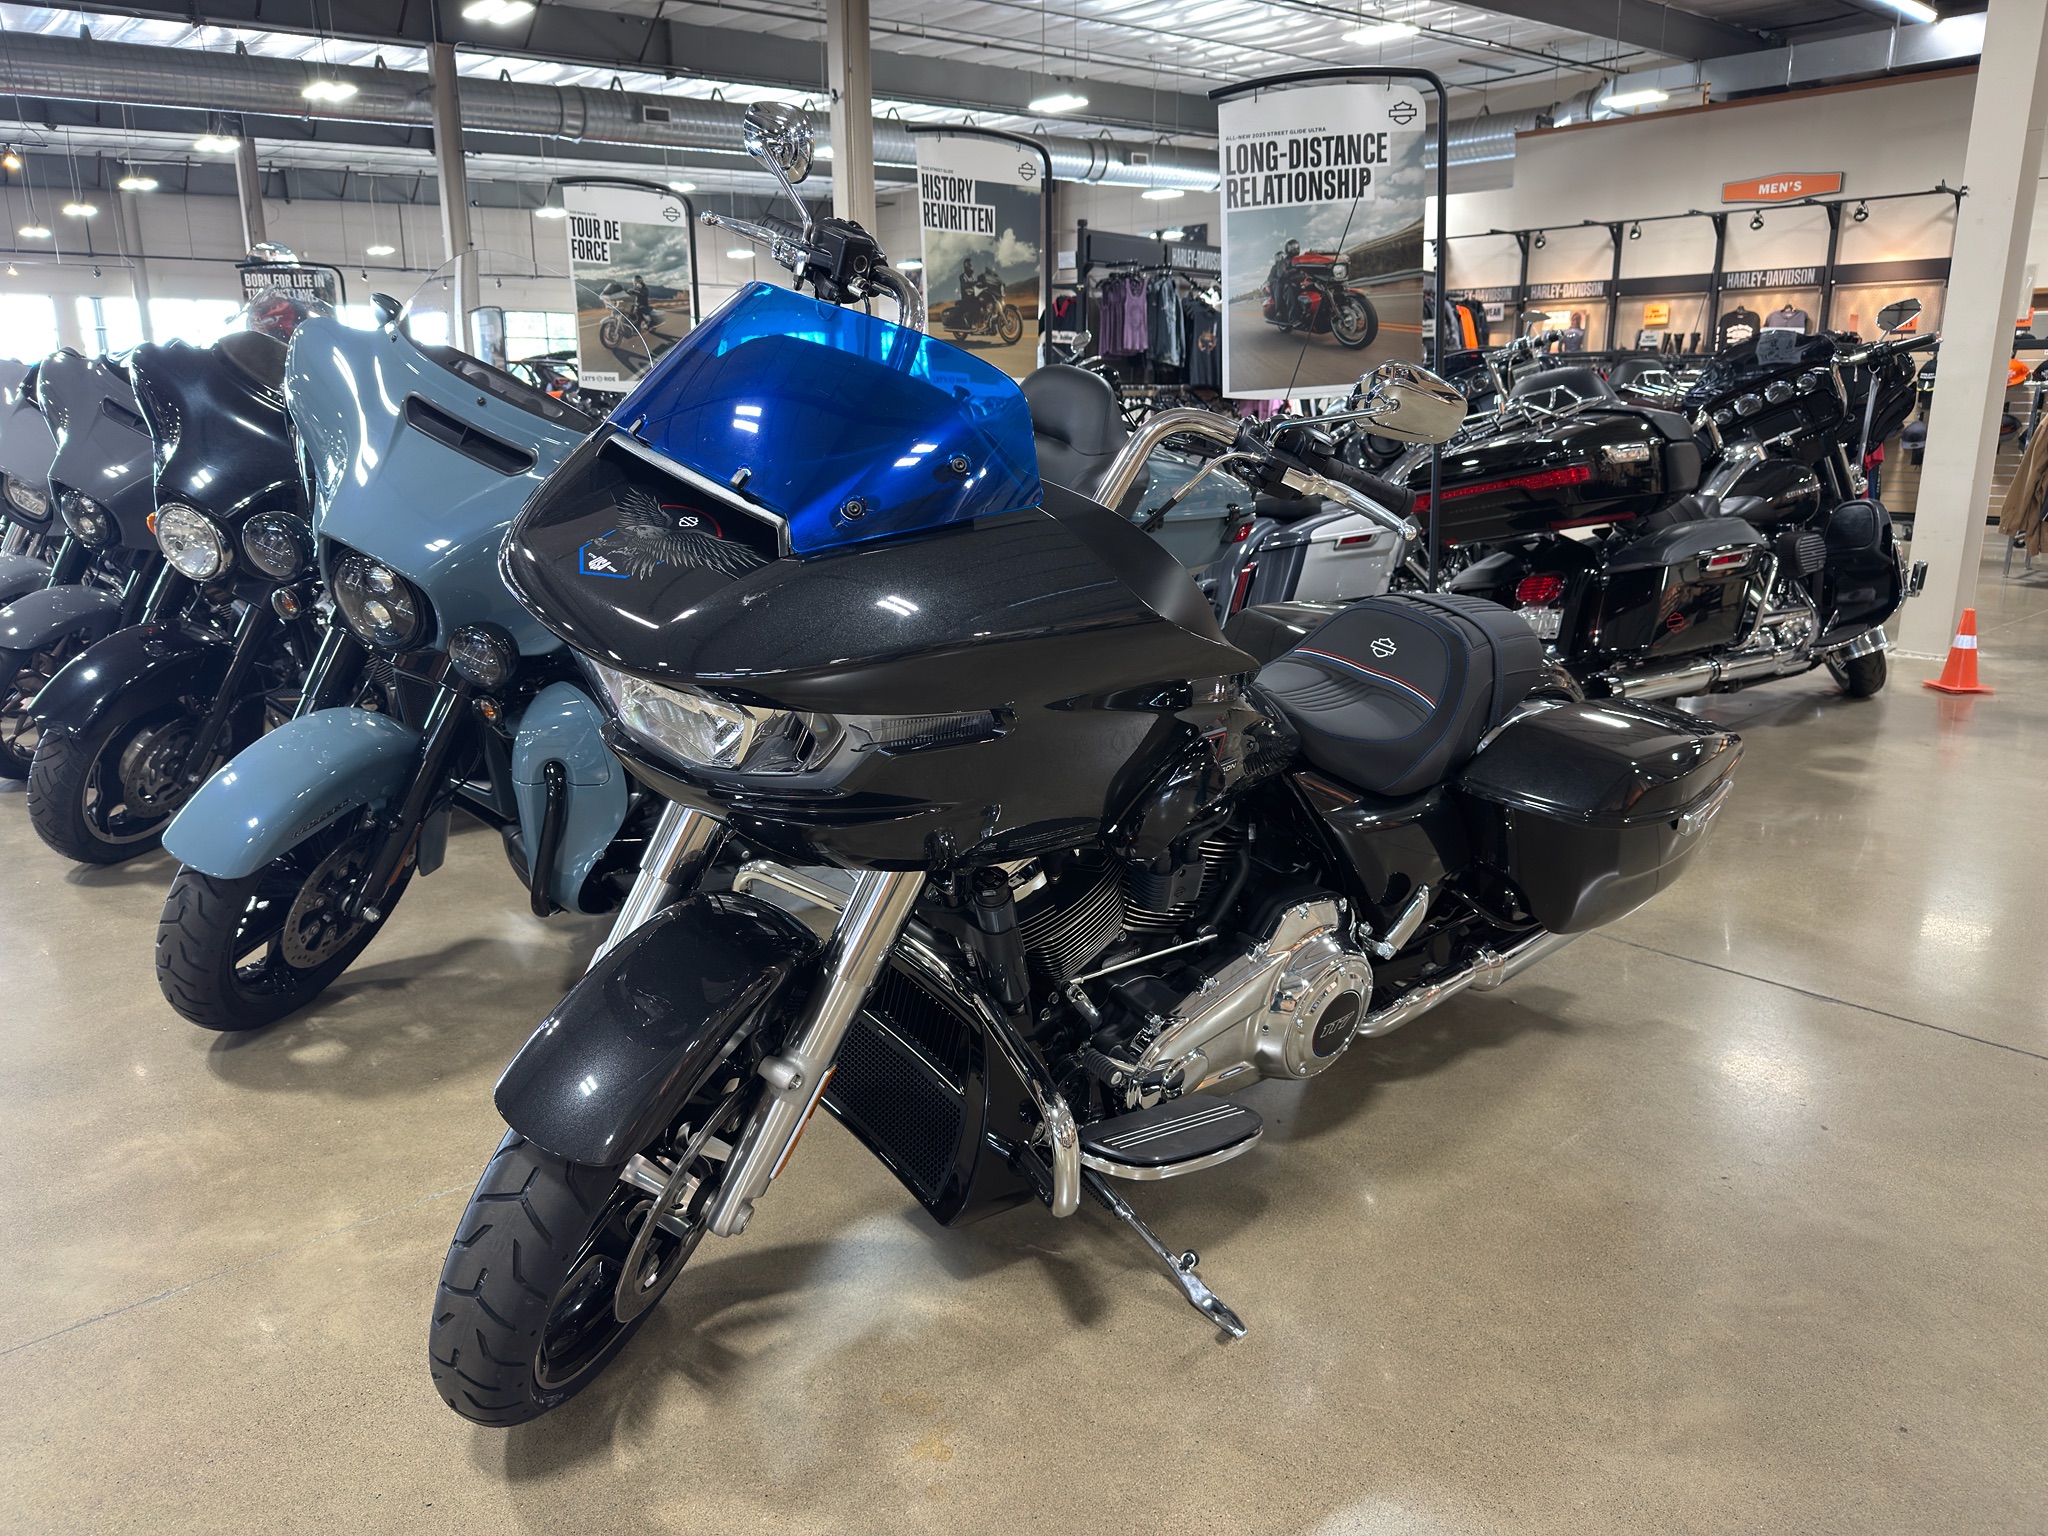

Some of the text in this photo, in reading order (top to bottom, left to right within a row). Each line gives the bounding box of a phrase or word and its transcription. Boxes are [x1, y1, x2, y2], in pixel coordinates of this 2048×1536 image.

[1226, 132, 1387, 176] LONG-DISTANCE
[921, 173, 973, 204] HISTORY
[1226, 167, 1371, 209] RELATIONSHIP
[1758, 181, 1802, 195] MEN'S
[569, 216, 620, 241] TOUR DE
[923, 201, 993, 233] REWRITTEN
[571, 238, 609, 262] FORCE
[244, 273, 325, 288] BORN FOR LIFE IN
[1726, 268, 1816, 288] HARLEY-DAVIDSON
[1530, 282, 1604, 299] HARLEY-DAVIDSON
